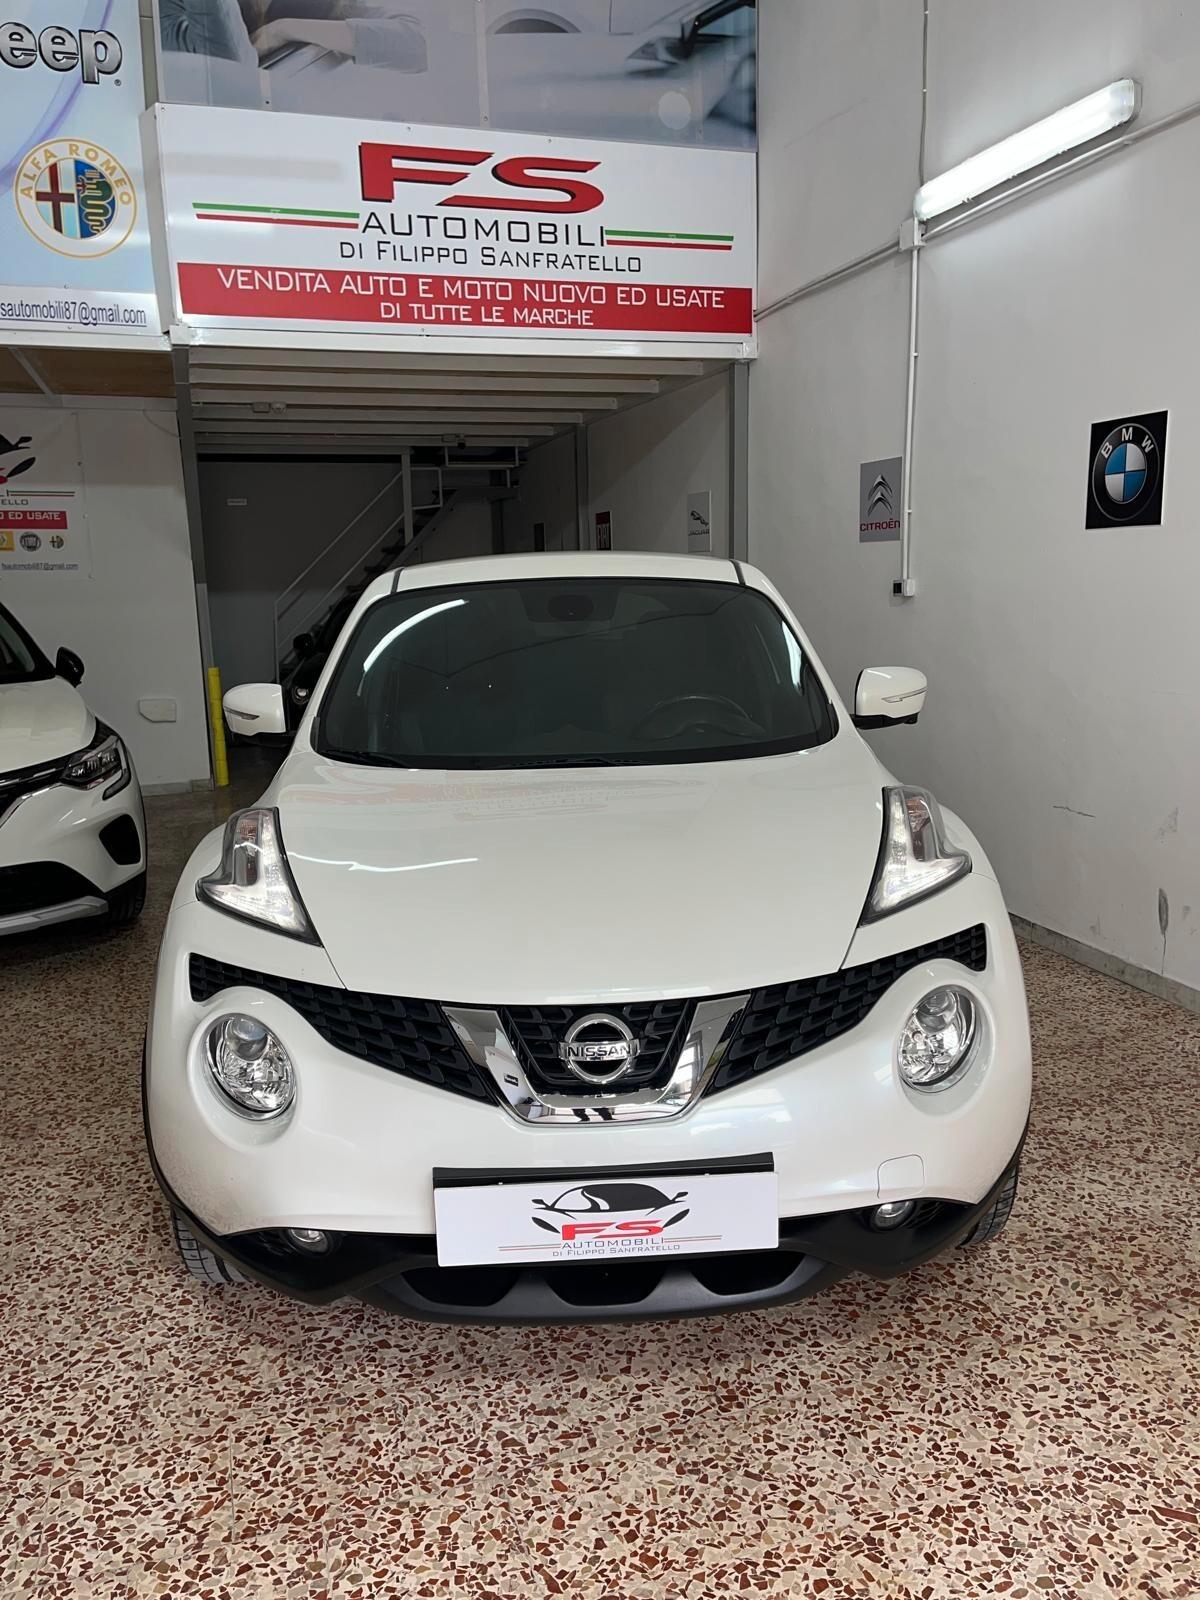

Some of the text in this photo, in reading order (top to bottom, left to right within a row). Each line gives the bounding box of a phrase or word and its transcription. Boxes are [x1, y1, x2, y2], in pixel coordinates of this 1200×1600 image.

[20, 143, 132, 206] ALFA ROMEO
[358, 142, 604, 214] FS
[361, 211, 604, 247] AUTOMOBILI
[340, 240, 641, 272] DI FILIPPO SANFRATELLO
[217, 267, 725, 308] VENDITA AUTO E MOTO NUOVO ED USATE
[380, 302, 594, 326] DI TUTTE LE MARCHE
[1101, 426, 1154, 459] BMW
[8, 511, 23, 520] ED
[27, 511, 61, 520] USATE
[567, 1043, 631, 1058] NISSAN
[562, 1219, 663, 1241] FS
[562, 1237, 664, 1250] AUTOMOBILI
[567, 1248, 605, 1256] FILIPPO
[609, 1244, 681, 1254] SANFRATELLO
